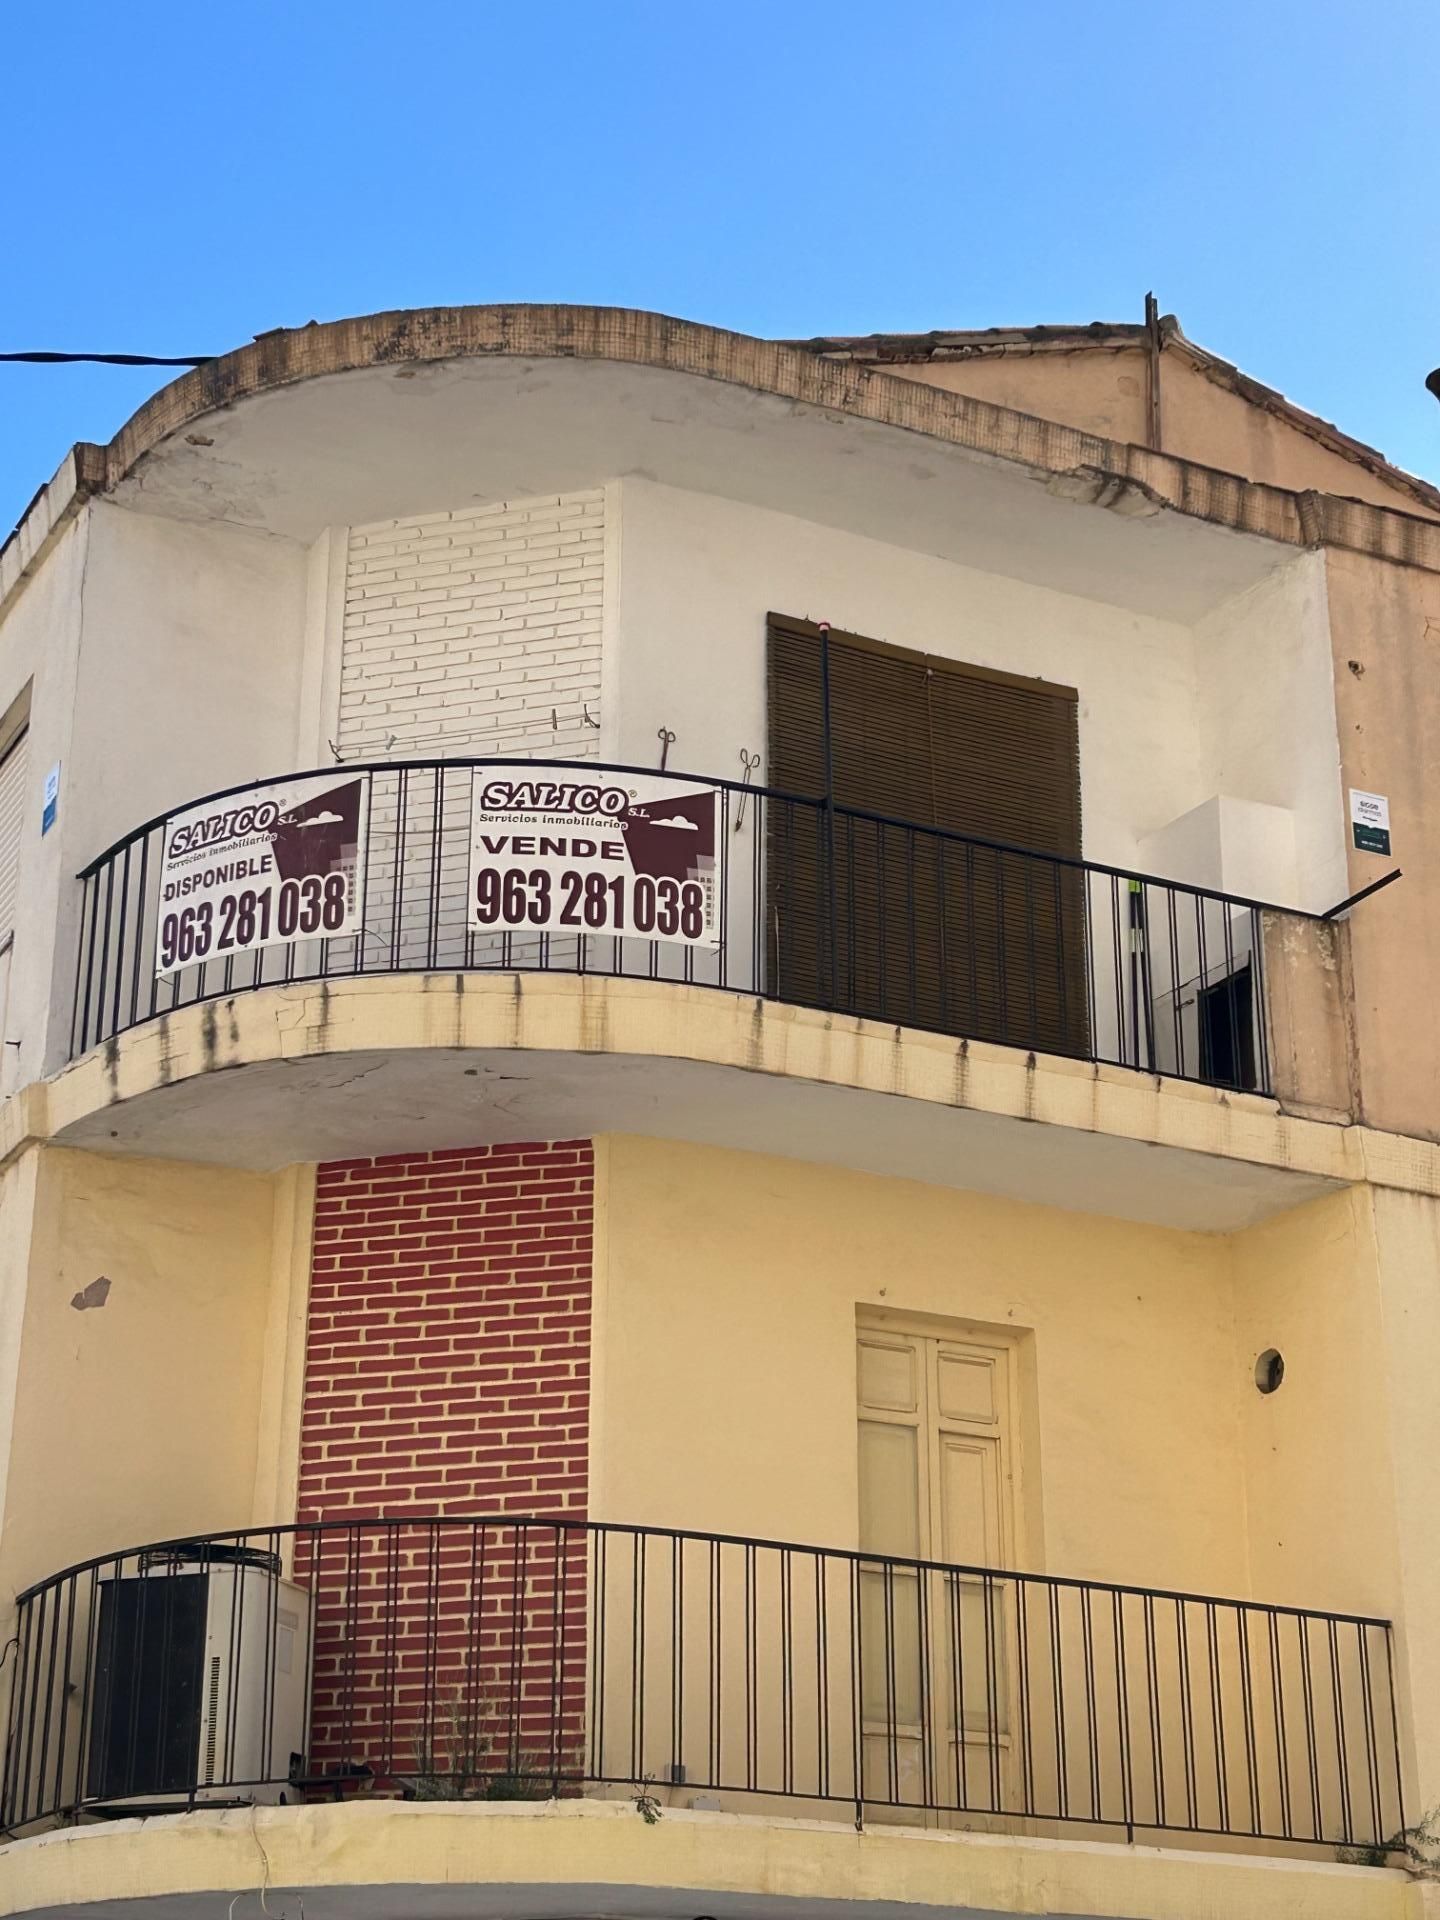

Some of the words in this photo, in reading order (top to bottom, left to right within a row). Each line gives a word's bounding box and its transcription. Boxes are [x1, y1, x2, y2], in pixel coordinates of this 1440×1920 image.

[480, 813, 537, 823] Servicios
[542, 814, 629, 831] inmobiliarios
[167, 851, 207, 870] Servicios
[209, 833, 277, 856] inmobiliarios
[480, 835, 625, 861] VENDE
[164, 854, 273, 901] DISPONIBLE
[161, 902, 213, 968] 963
[217, 886, 272, 950] 281
[278, 874, 345, 937] 038
[476, 868, 551, 924] 963
[559, 870, 625, 929] 281
[633, 876, 703, 939] 038
